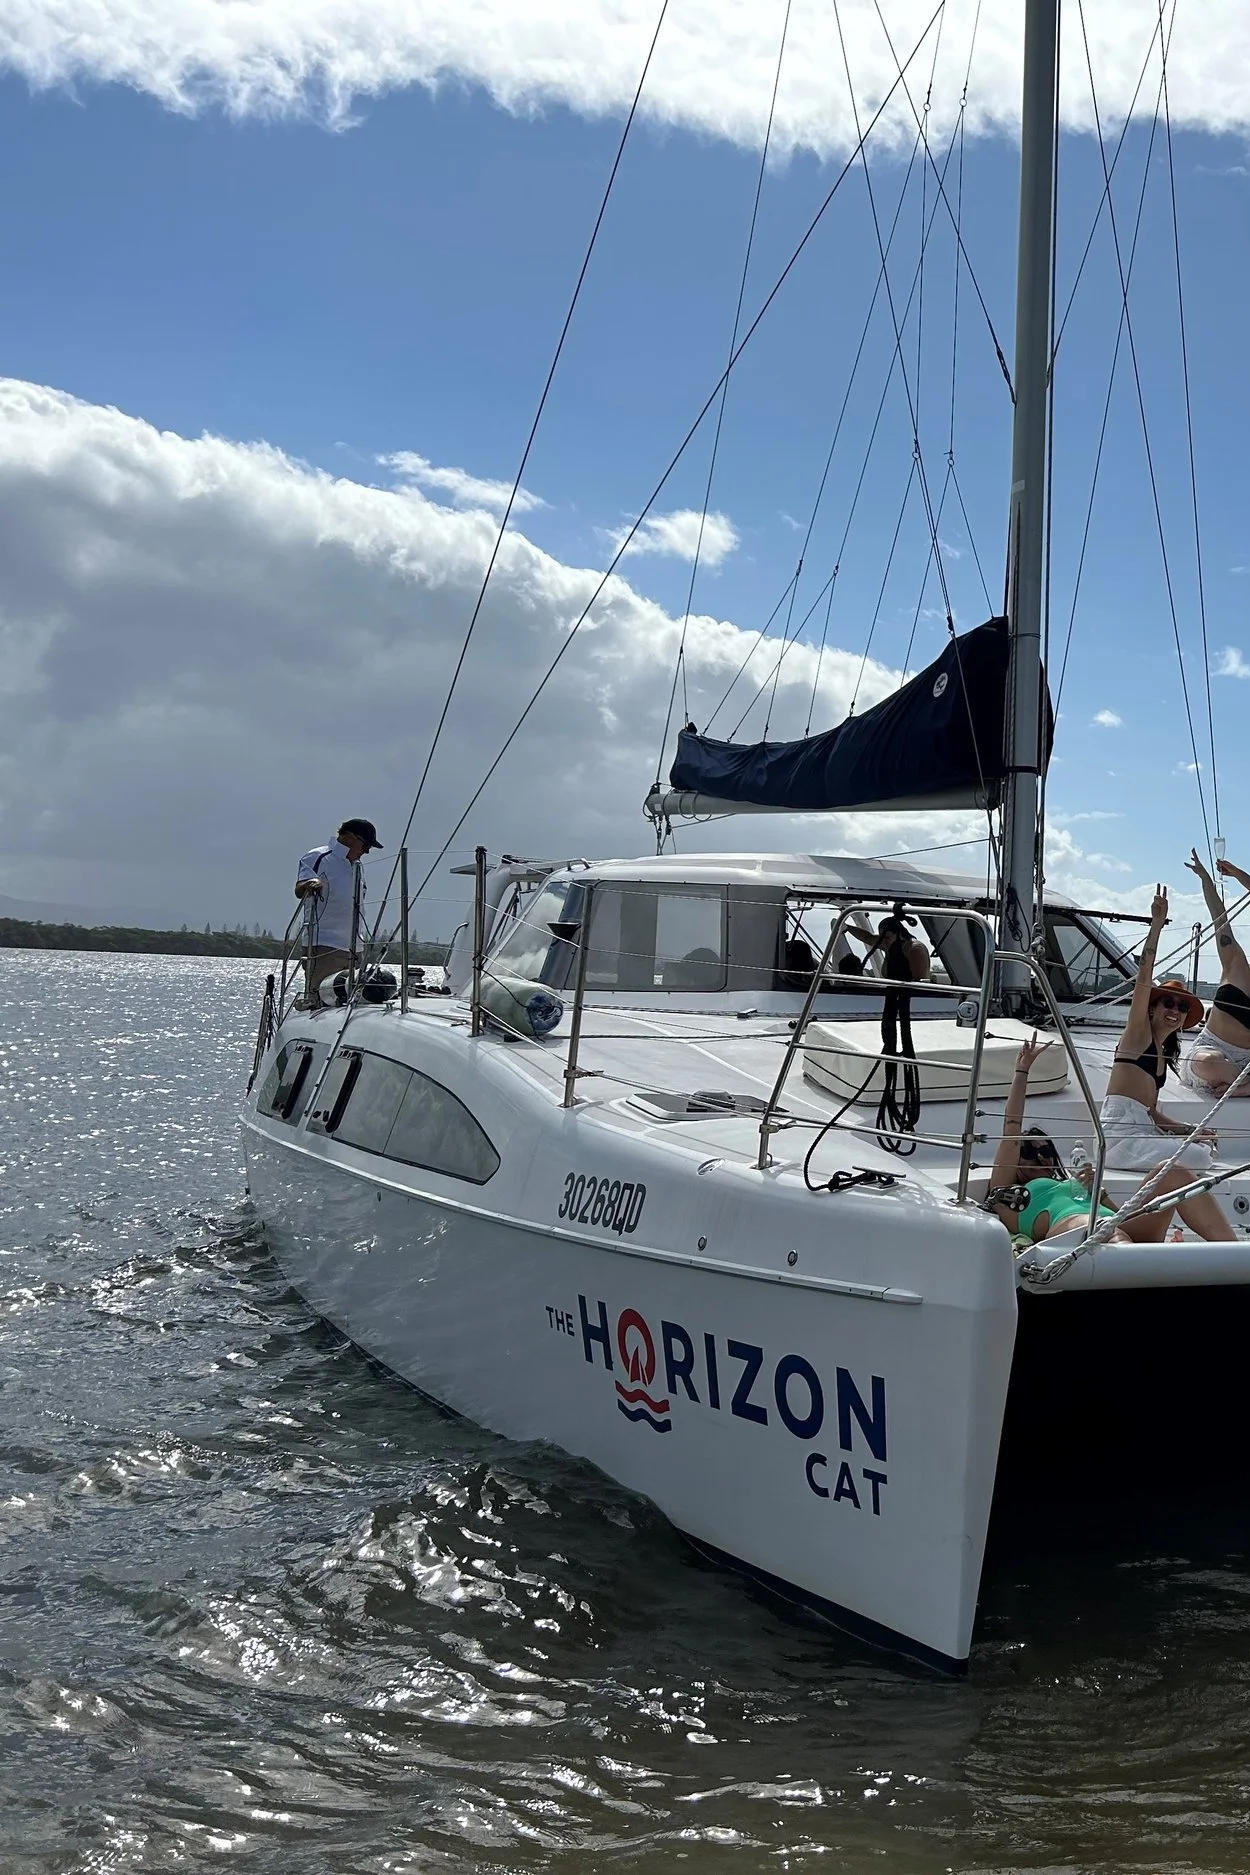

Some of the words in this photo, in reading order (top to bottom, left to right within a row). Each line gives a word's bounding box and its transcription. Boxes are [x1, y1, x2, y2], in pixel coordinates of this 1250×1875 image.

[558, 1171, 647, 1236] 30268QD
[545, 1305, 575, 1337] THE
[577, 1293, 888, 1463] HORIZON
[805, 1452, 888, 1516] CAT
